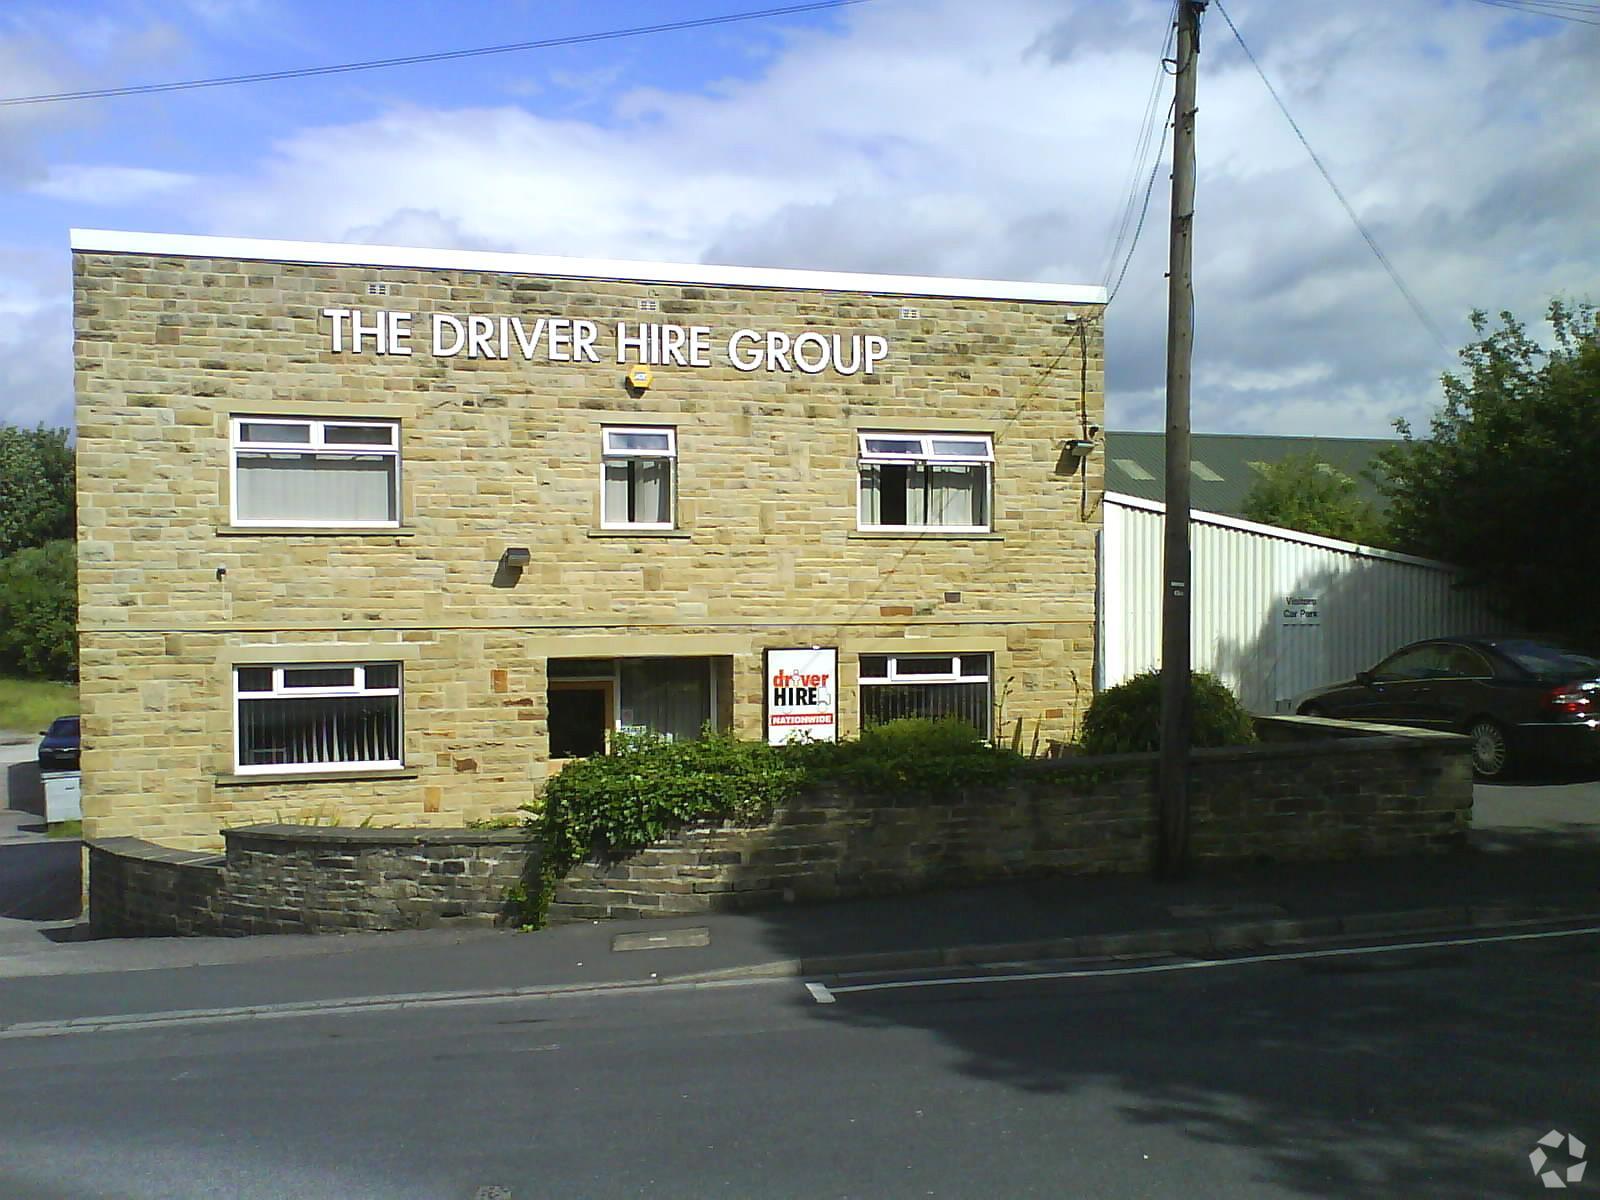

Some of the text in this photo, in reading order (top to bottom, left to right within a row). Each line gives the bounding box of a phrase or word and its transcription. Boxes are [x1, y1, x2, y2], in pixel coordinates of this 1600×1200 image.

[323, 309, 888, 375] THE DRIVER HIRE GROUP
[773, 669, 829, 687] driver
[774, 687, 817, 706] HIRE
[772, 715, 832, 725] NATIONWIDE
